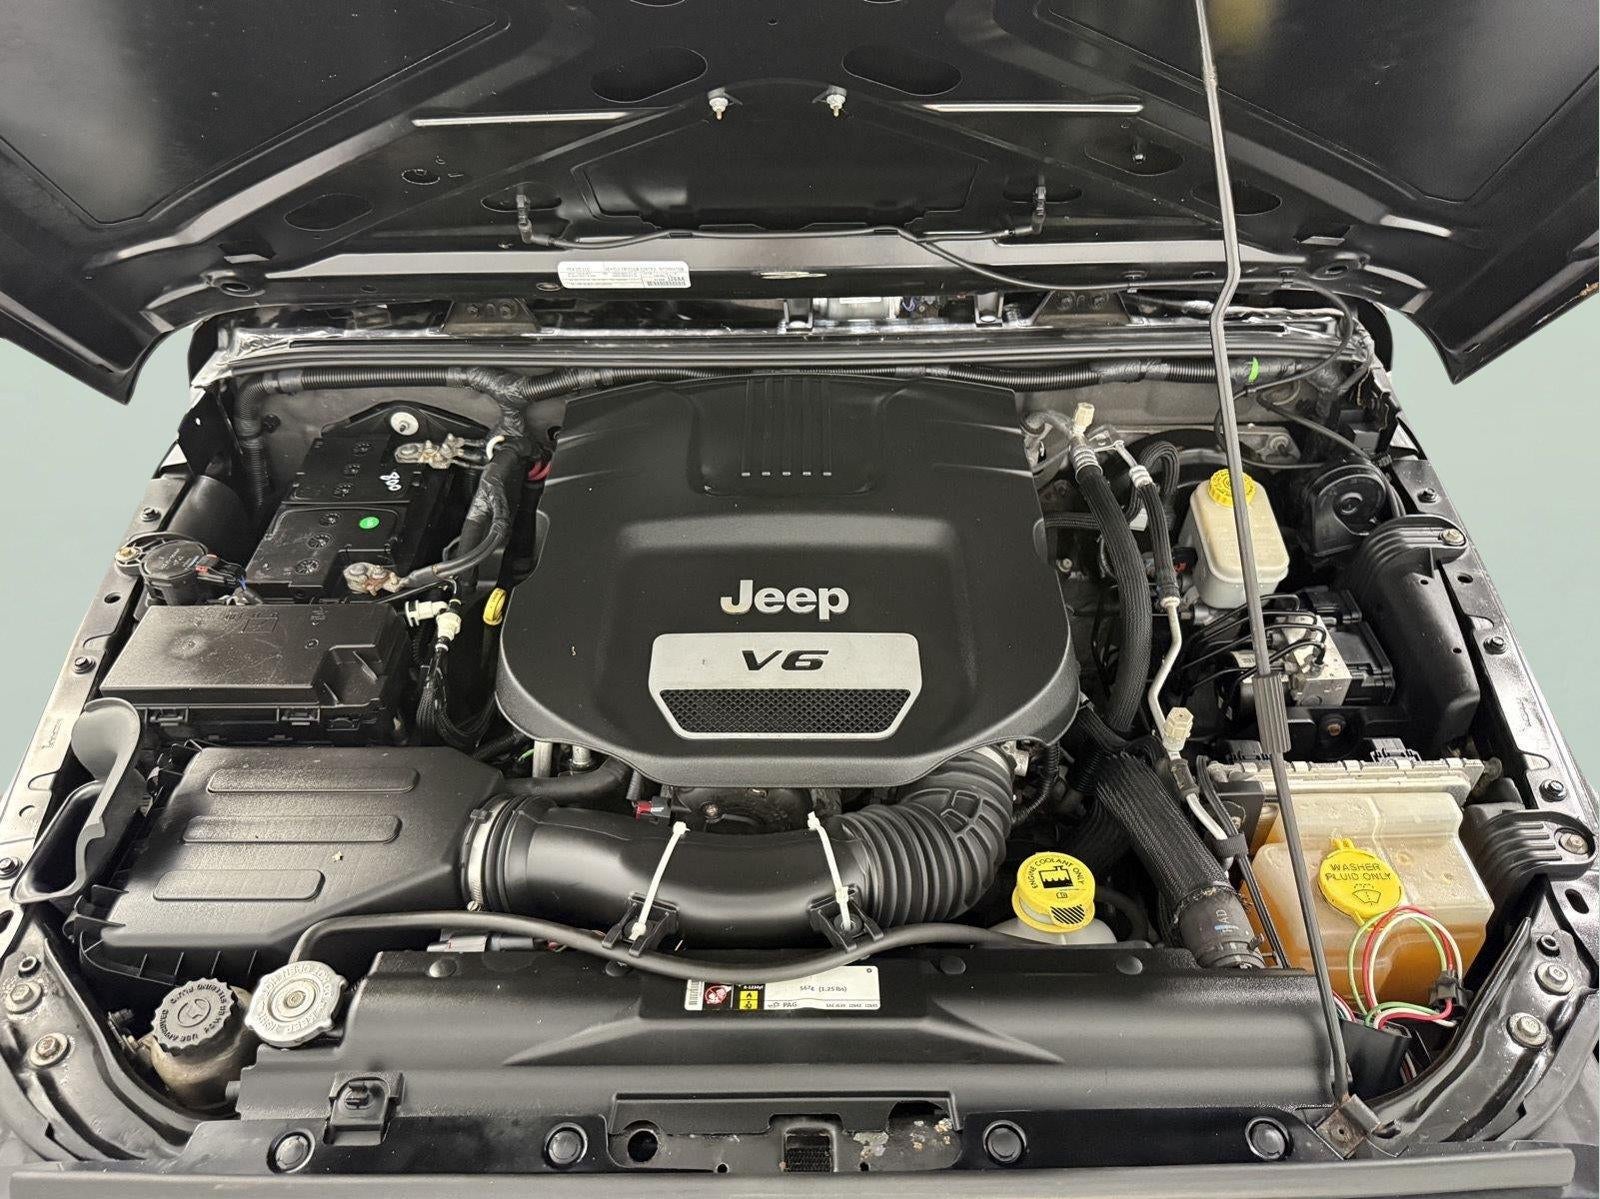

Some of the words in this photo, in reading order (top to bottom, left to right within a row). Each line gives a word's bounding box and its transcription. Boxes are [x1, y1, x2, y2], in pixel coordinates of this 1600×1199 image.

[720, 579, 850, 621] Jeep
[742, 650, 829, 671] V6
[1028, 866, 1038, 889] ENGINE
[1035, 858, 1072, 867] COOLANT
[1073, 867, 1085, 885] ONLY
[1325, 872, 1359, 881] FLUID
[1362, 872, 1391, 880] ONLY
[1330, 863, 1381, 871] WASHER
